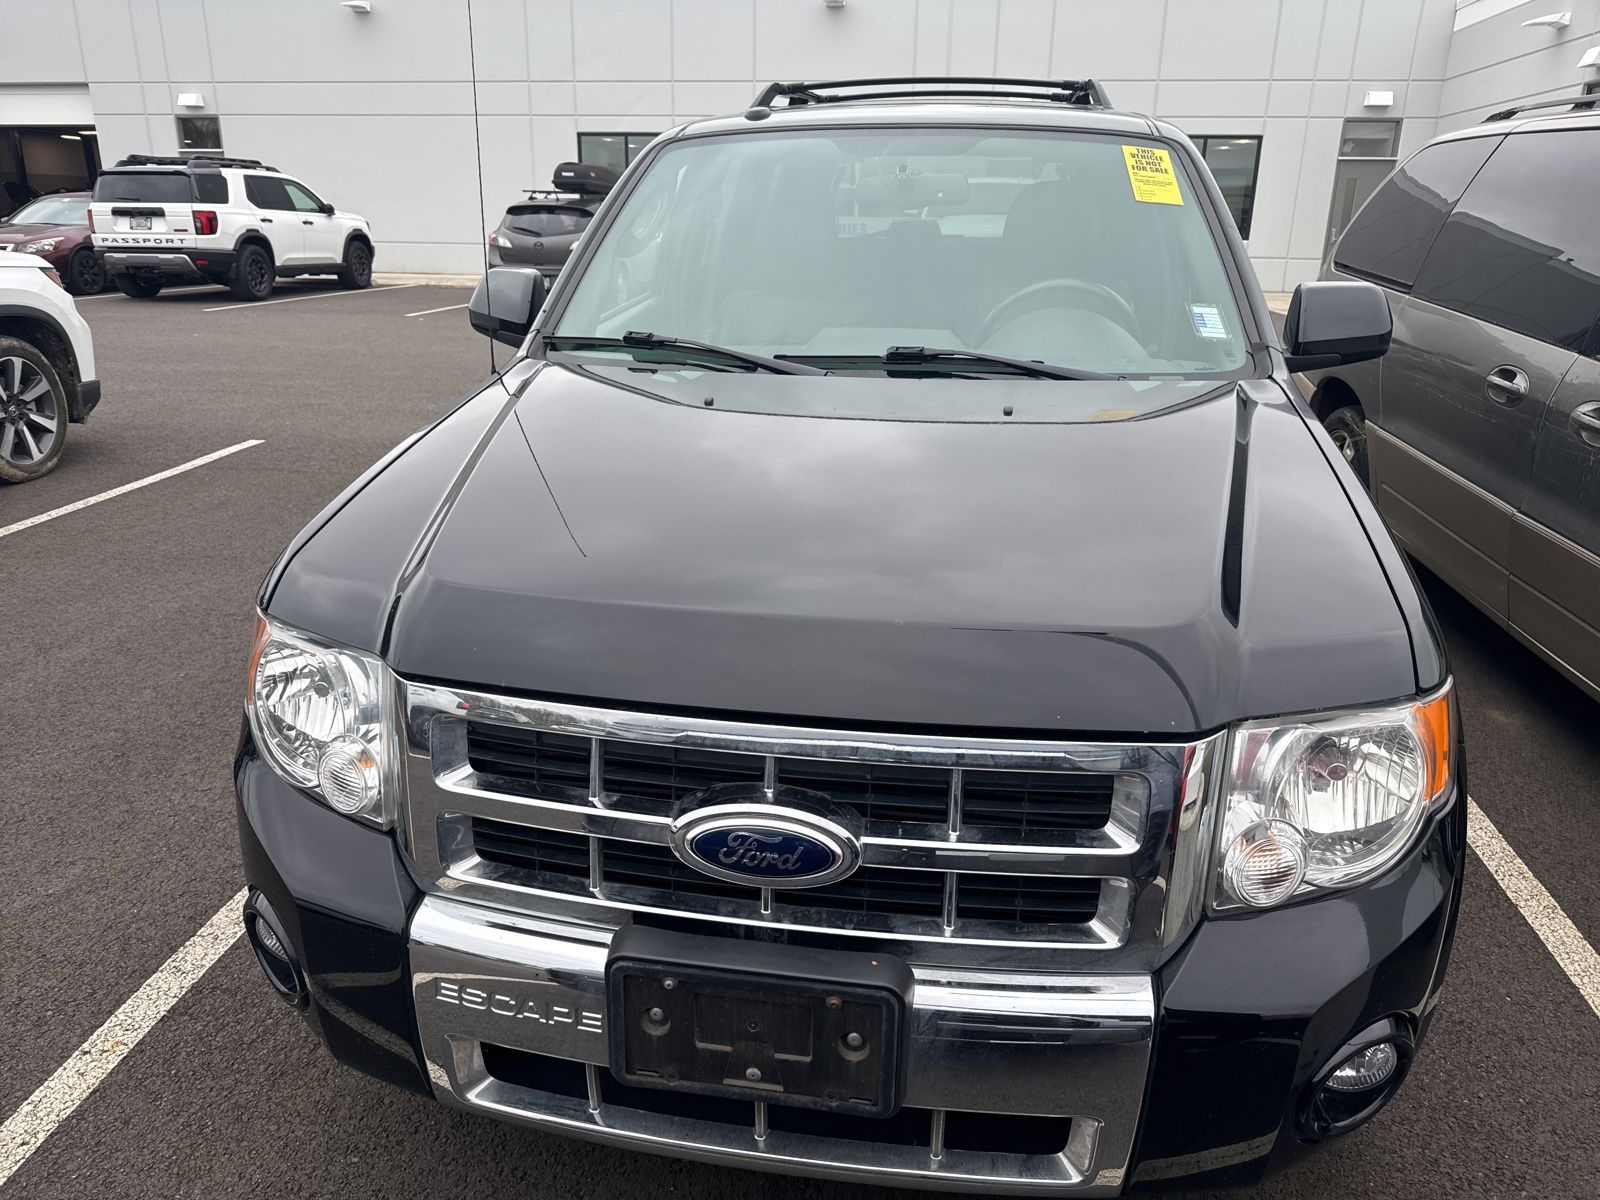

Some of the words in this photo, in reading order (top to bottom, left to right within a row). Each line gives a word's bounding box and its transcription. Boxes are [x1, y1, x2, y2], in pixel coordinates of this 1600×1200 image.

[1130, 152, 1164, 162] VEHICLE
[1145, 160, 1162, 168] NOT
[1131, 164, 1148, 172] FOR
[1149, 166, 1169, 175] SALE
[101, 237, 186, 245] PASSPORT
[718, 831, 804, 871] Ford
[435, 979, 603, 1033] ESCAPE
